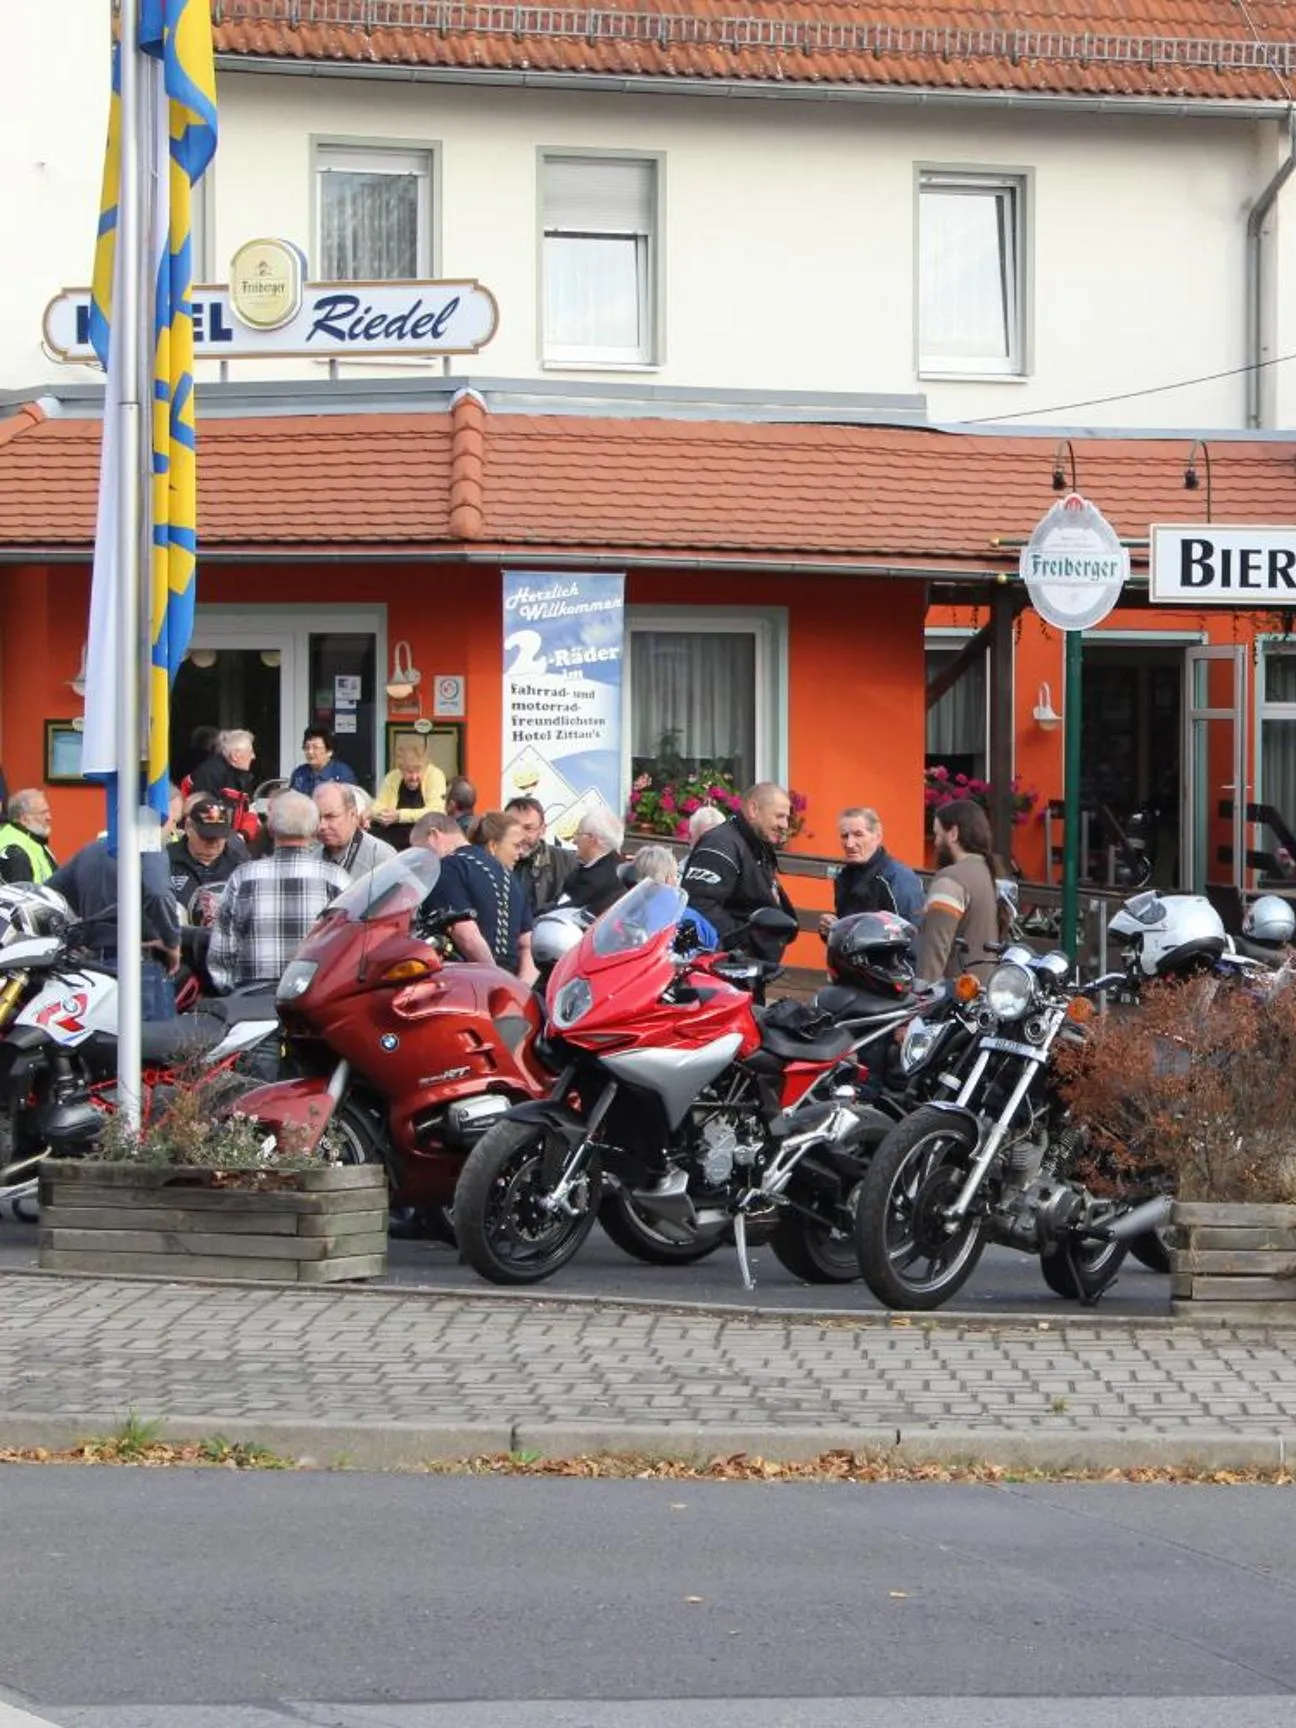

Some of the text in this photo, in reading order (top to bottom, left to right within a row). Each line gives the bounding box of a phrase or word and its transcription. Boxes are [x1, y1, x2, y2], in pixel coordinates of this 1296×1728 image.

[307, 294, 460, 342] Riedel
[1031, 554, 1119, 581] Freiberger
[505, 582, 580, 609] Herzlich
[519, 598, 623, 621] Willkommen
[573, 690, 596, 700] und
[511, 702, 581, 713] motorrad-
[512, 729, 551, 742] Hotel
